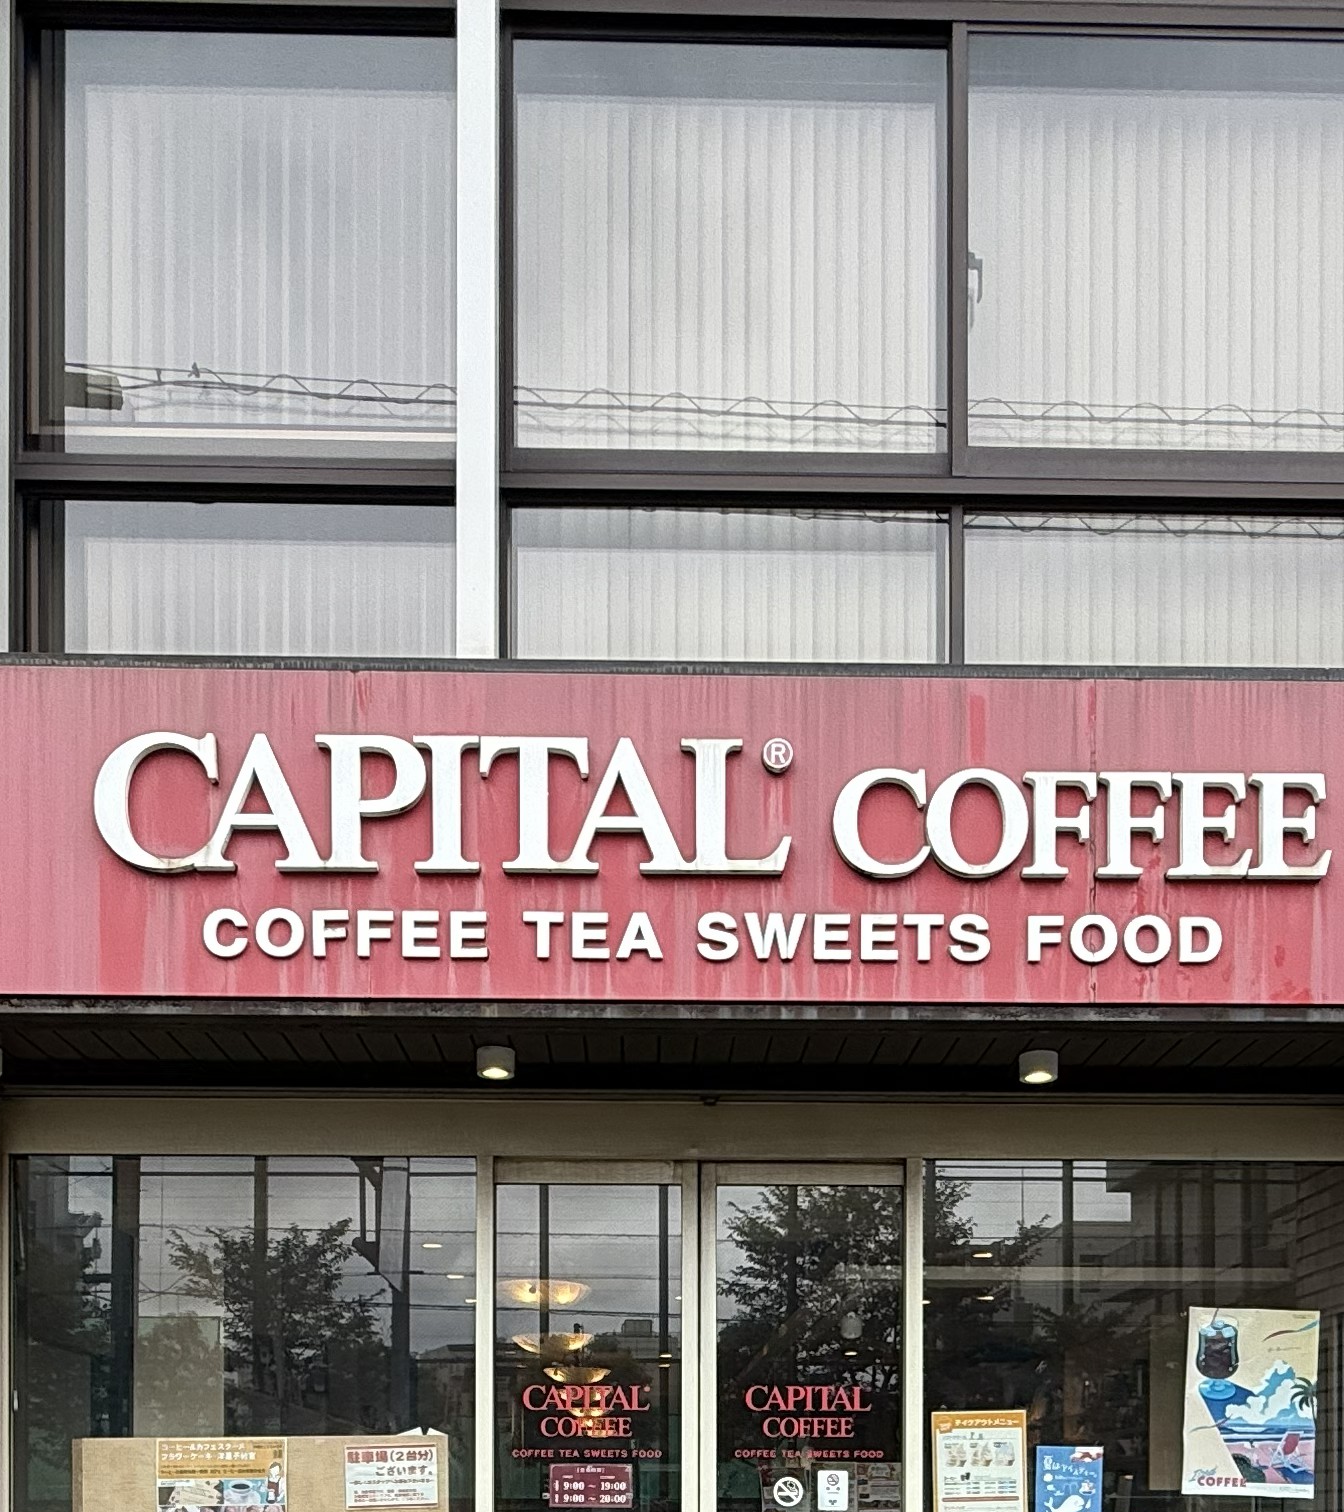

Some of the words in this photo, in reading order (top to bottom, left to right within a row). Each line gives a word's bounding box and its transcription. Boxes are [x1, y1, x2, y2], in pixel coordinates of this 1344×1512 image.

[832, 767, 1335, 881] COFFEE
[202, 907, 490, 959] COFFEE
[522, 909, 666, 960] TEA
[696, 910, 992, 964] SWEETS
[1025, 913, 1225, 965] FOOD
[522, 1384, 651, 1411] CAPITAL
[745, 1384, 873, 1412] CAPITAL
[540, 1416, 633, 1438] COFFEE
[762, 1416, 855, 1438] COFFEE
[511, 1449, 555, 1458] COFFEE
[560, 1450, 580, 1458] TEA
[584, 1450, 628, 1458] SWEETS
[632, 1450, 663, 1458] FOOD
[734, 1449, 777, 1458] COFFEE
[782, 1450, 801, 1458] TEA
[807, 1450, 850, 1458] SWEETS
[854, 1450, 884, 1458] FOOD
[375, 1464, 433, 1476] ございます。
[1197, 1475, 1247, 1487] COFFEE
